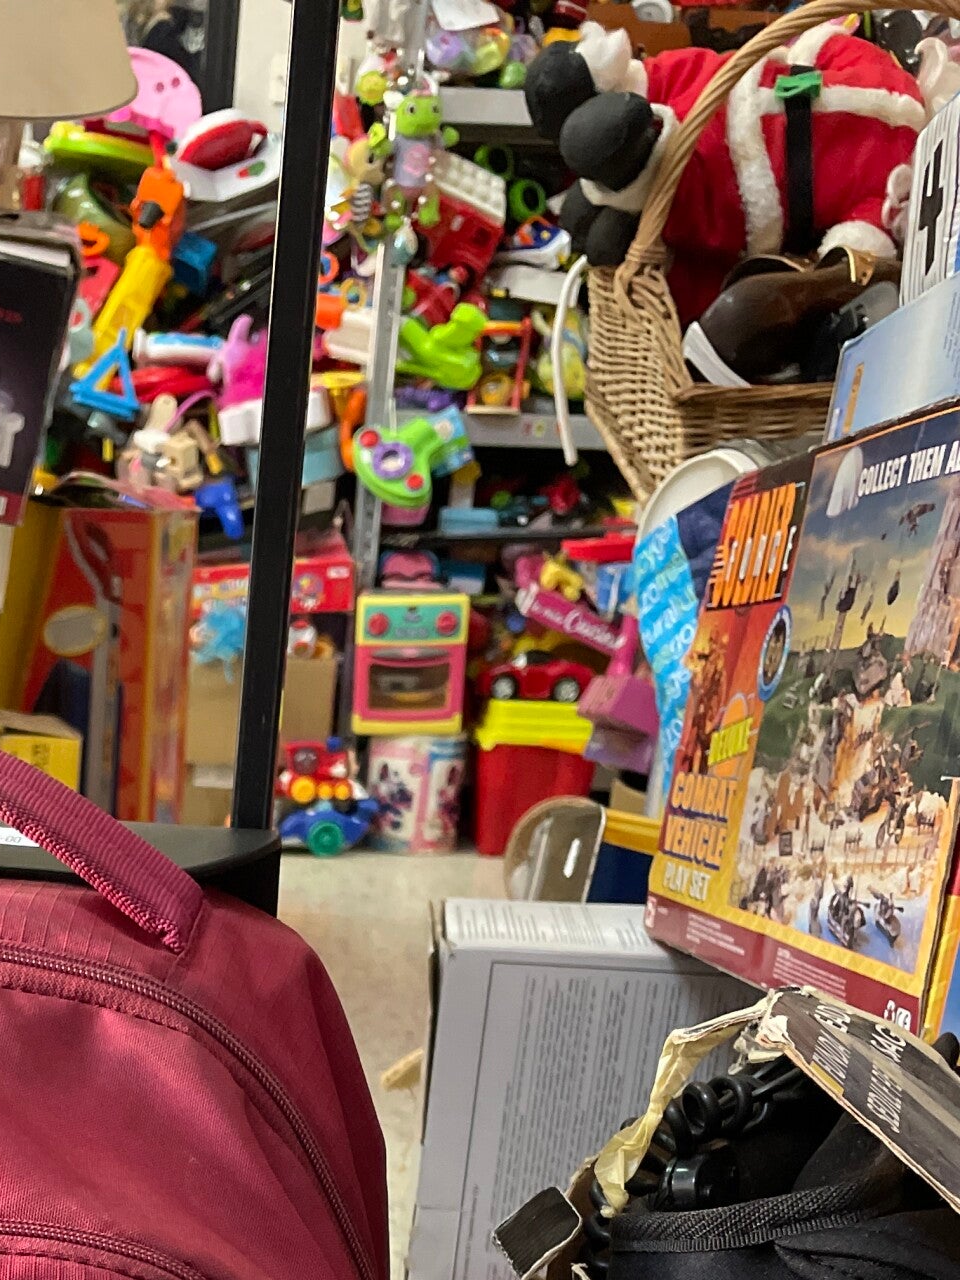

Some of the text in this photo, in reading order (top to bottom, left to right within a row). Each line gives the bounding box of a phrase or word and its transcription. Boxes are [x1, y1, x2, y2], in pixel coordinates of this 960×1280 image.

[858, 454, 907, 498] COLLECT
[907, 443, 947, 484] THEM
[671, 770, 739, 824] COMBAT
[664, 813, 729, 872] VEHICLE
[662, 861, 711, 902] PLAY SET
